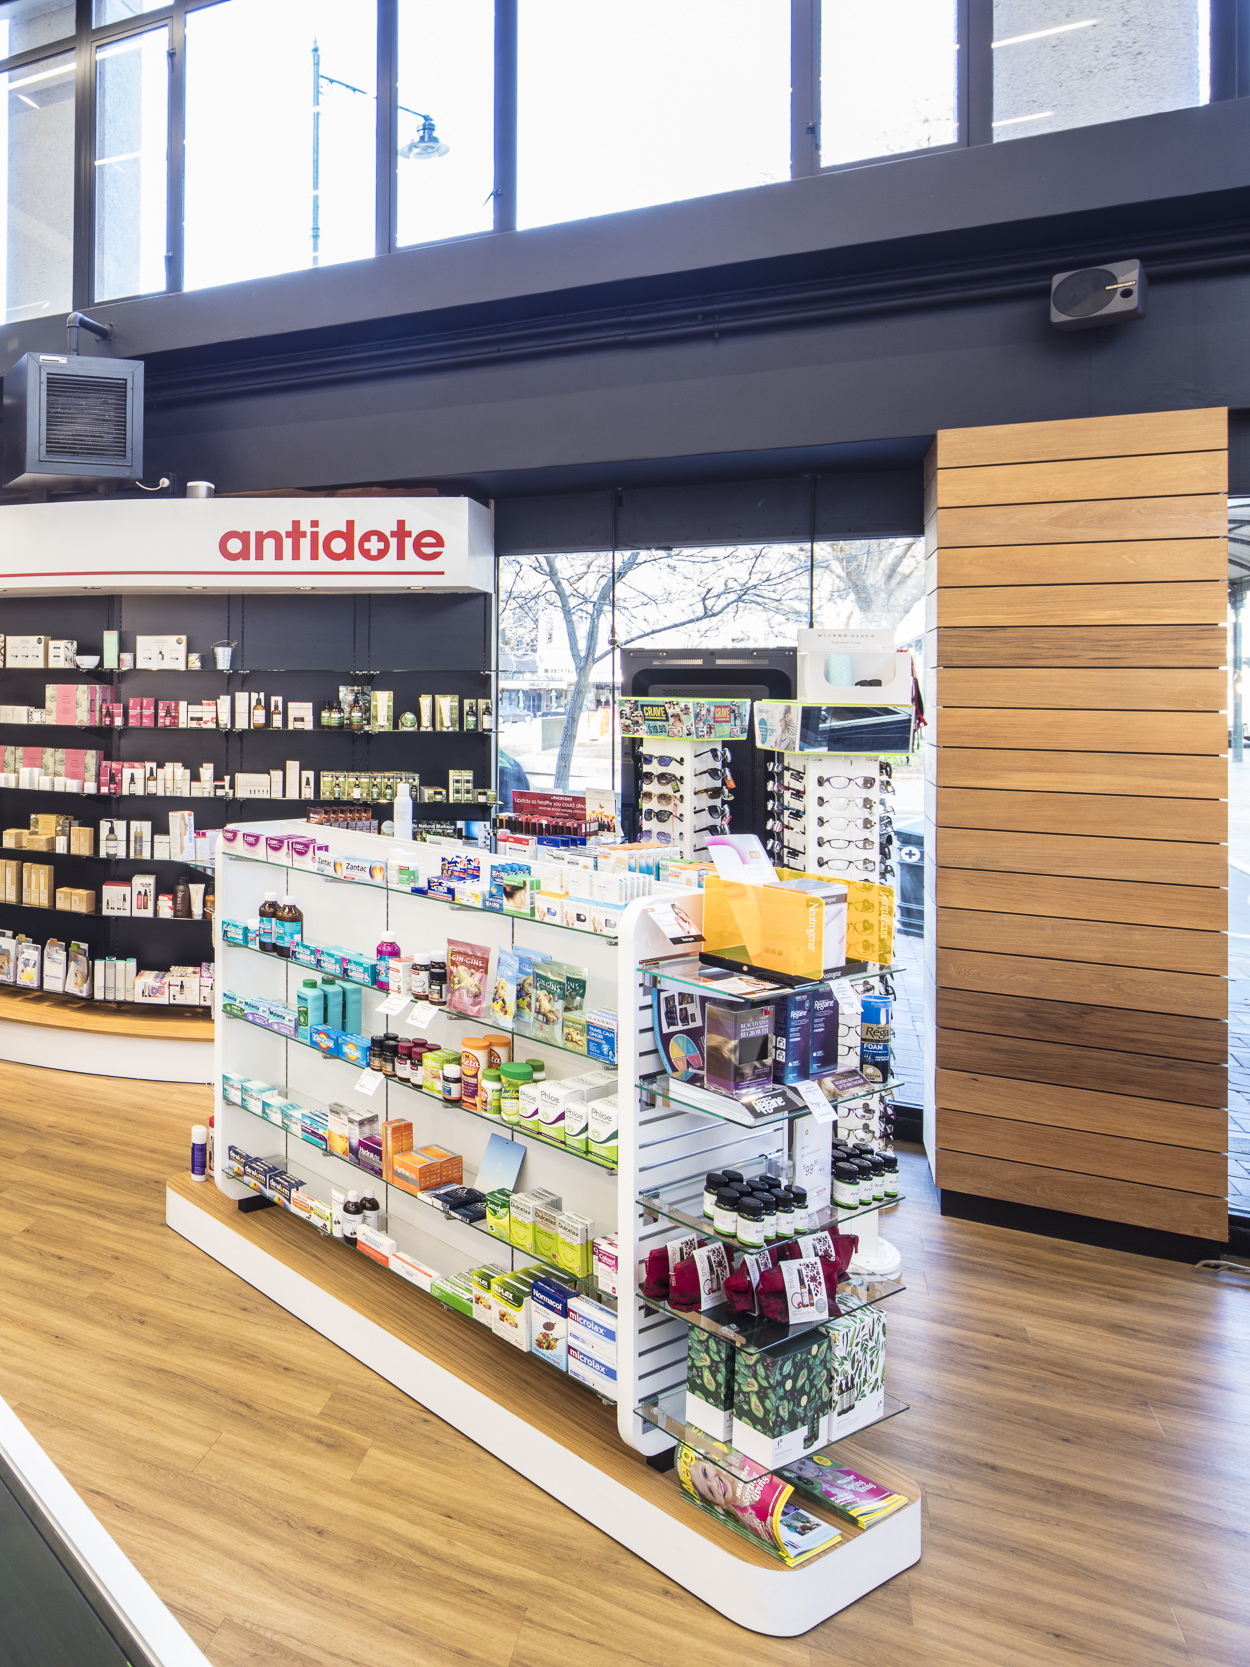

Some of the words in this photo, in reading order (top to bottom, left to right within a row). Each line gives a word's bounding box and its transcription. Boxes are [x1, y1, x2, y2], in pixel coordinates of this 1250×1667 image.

[219, 520, 445, 561] antidote
[643, 706, 666, 719] CRAVE
[714, 707, 731, 720] CRAVE
[317, 857, 332, 868] Zantac
[345, 863, 367, 873] Zantac
[808, 901, 819, 952] Neutrogena
[223, 992, 237, 1002] Mylanta
[244, 1000, 260, 1012] Mylanta
[814, 999, 835, 1011] Regaine
[269, 1010, 286, 1021] Mylanta
[790, 1010, 807, 1020] Regaine
[424, 1057, 441, 1069] mintec
[520, 1090, 537, 1103] Phloe
[540, 1090, 560, 1104] Phloe
[565, 1107, 584, 1121] Phloe
[591, 1107, 613, 1122] Phloe
[359, 1146, 380, 1161] Hydralyte
[394, 1163, 417, 1180] Hydralyte
[510, 1202, 532, 1216] Dulcolax
[534, 1210, 557, 1226] Dulcolax
[557, 1221, 580, 1238] Dulcolax
[533, 1288, 563, 1311] Normacol
[569, 1310, 605, 1336] microlax
[569, 1347, 606, 1374] microlax
[751, 1472, 771, 1502] living
